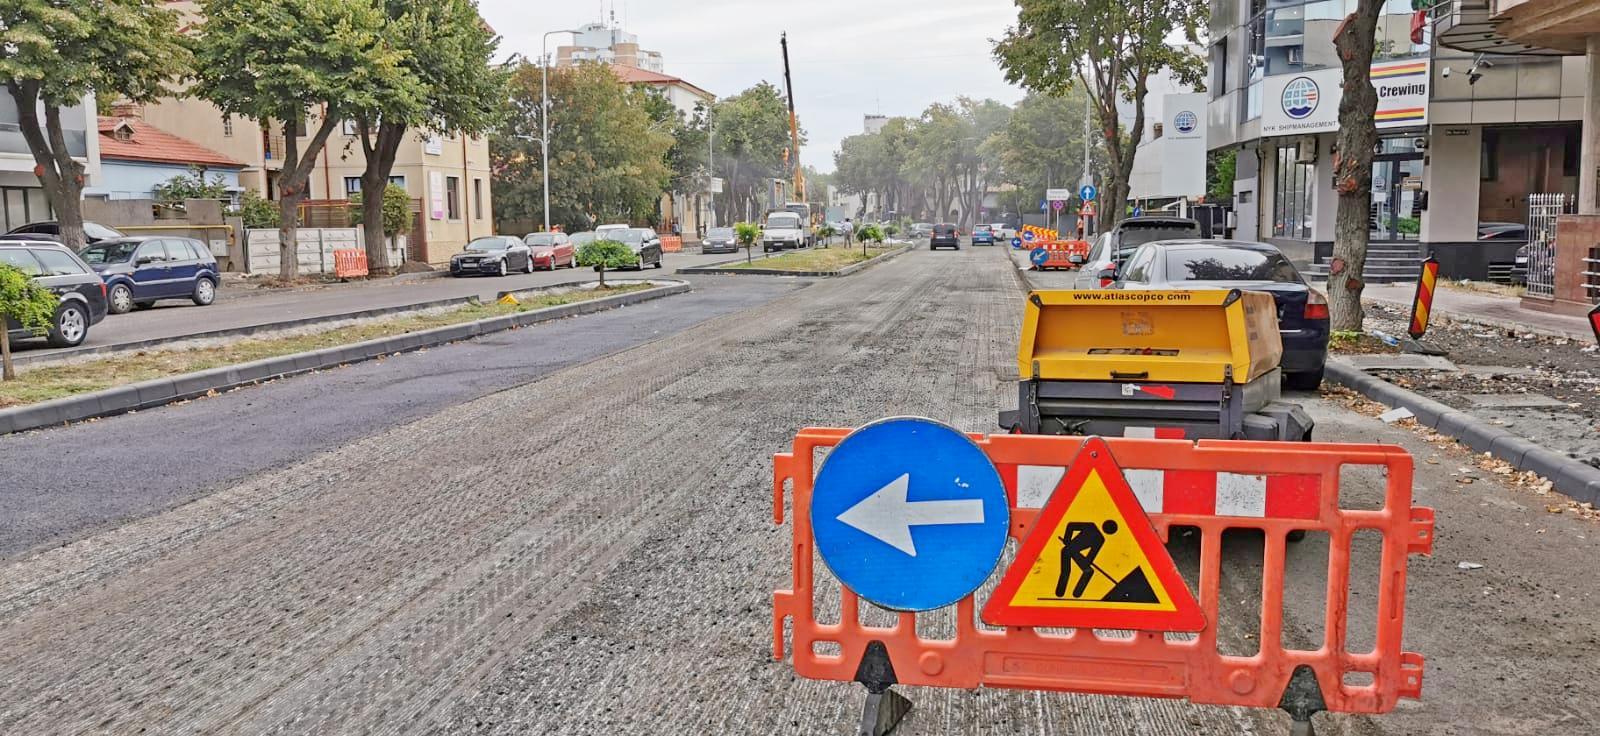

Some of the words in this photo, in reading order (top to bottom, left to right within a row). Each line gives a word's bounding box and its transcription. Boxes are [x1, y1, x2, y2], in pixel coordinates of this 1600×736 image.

[1380, 83, 1425, 98] Crewing
[1279, 120, 1337, 131] SHIPMANAGEMENT
[1073, 292, 1191, 302] www.atlascopcocom
